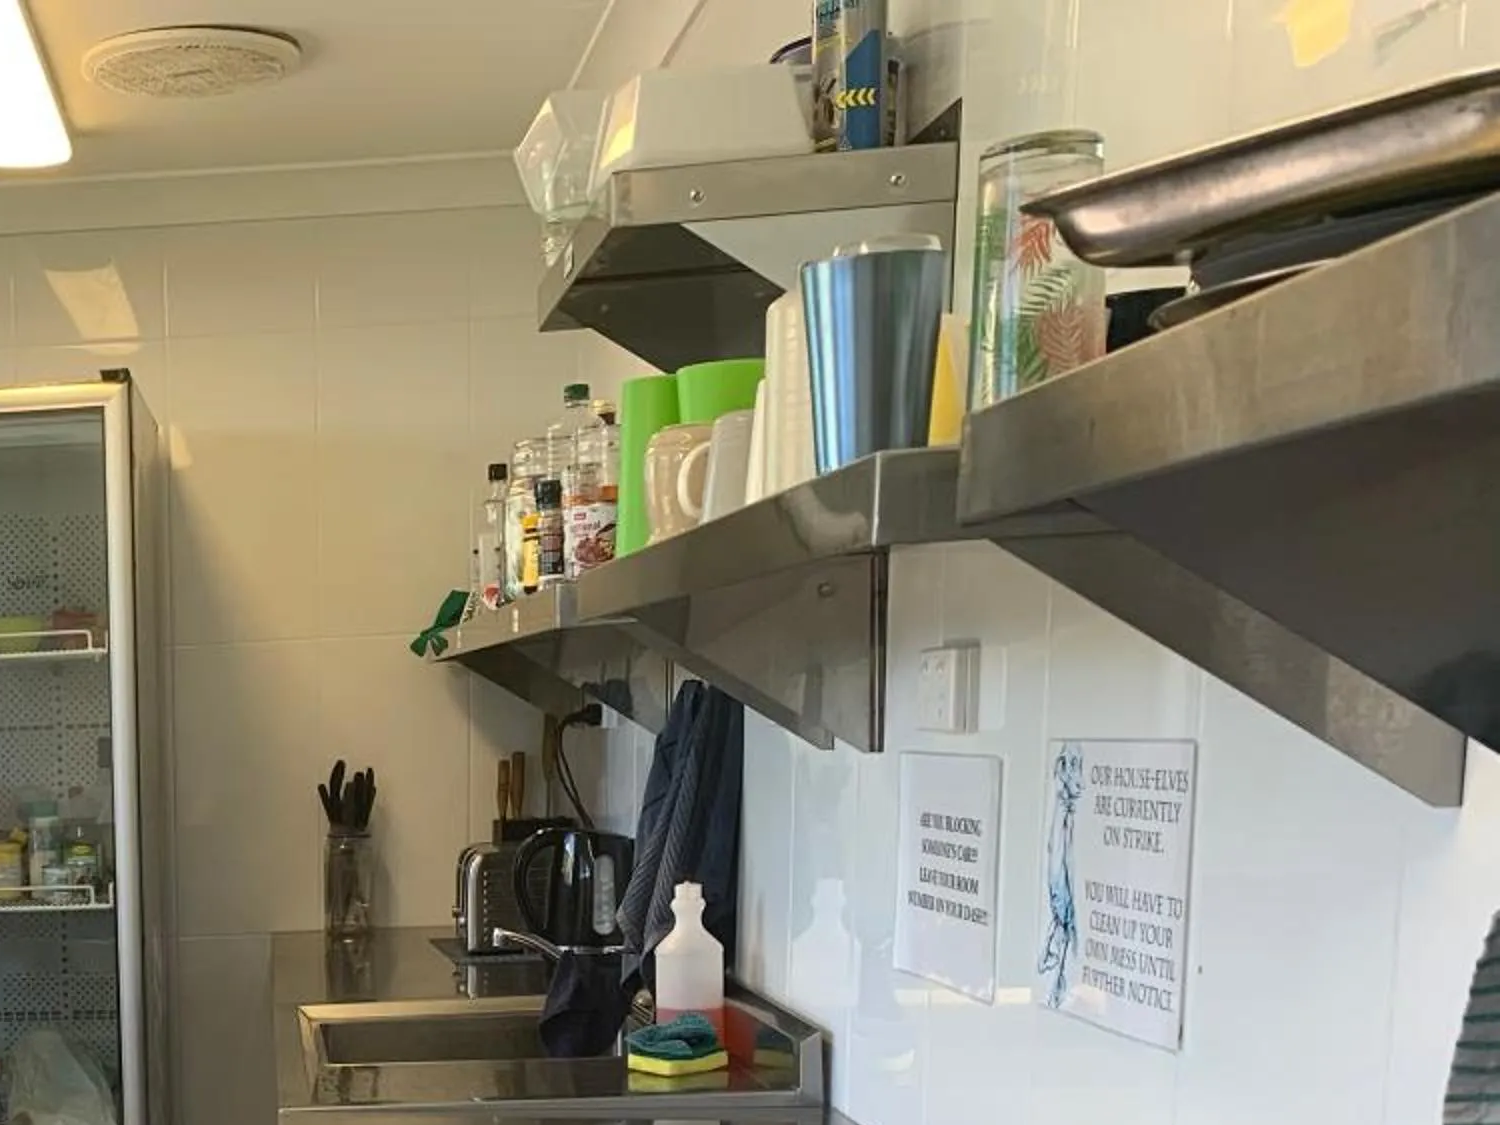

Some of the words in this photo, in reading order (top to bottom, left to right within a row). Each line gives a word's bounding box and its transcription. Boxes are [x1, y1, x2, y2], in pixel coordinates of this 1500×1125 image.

[1091, 765, 1113, 787] OUR
[1114, 767, 1189, 793] HOUSE-ELVES
[1094, 795, 1113, 817] ARE
[1114, 797, 1182, 824] CURRENTLY
[1103, 825, 1121, 847] ON
[1084, 878, 1105, 902] YOU
[1105, 883, 1130, 909] WILL
[1131, 889, 1164, 916] HAVE
[1167, 895, 1185, 920] TO
[1089, 909, 1121, 936] CLEAN
[1123, 918, 1138, 940] UP
[1139, 921, 1173, 949] YOUR
[1110, 944, 1138, 971] MESS
[1139, 951, 1176, 982] UNTIL
[1081, 965, 1126, 997] FURTHER
